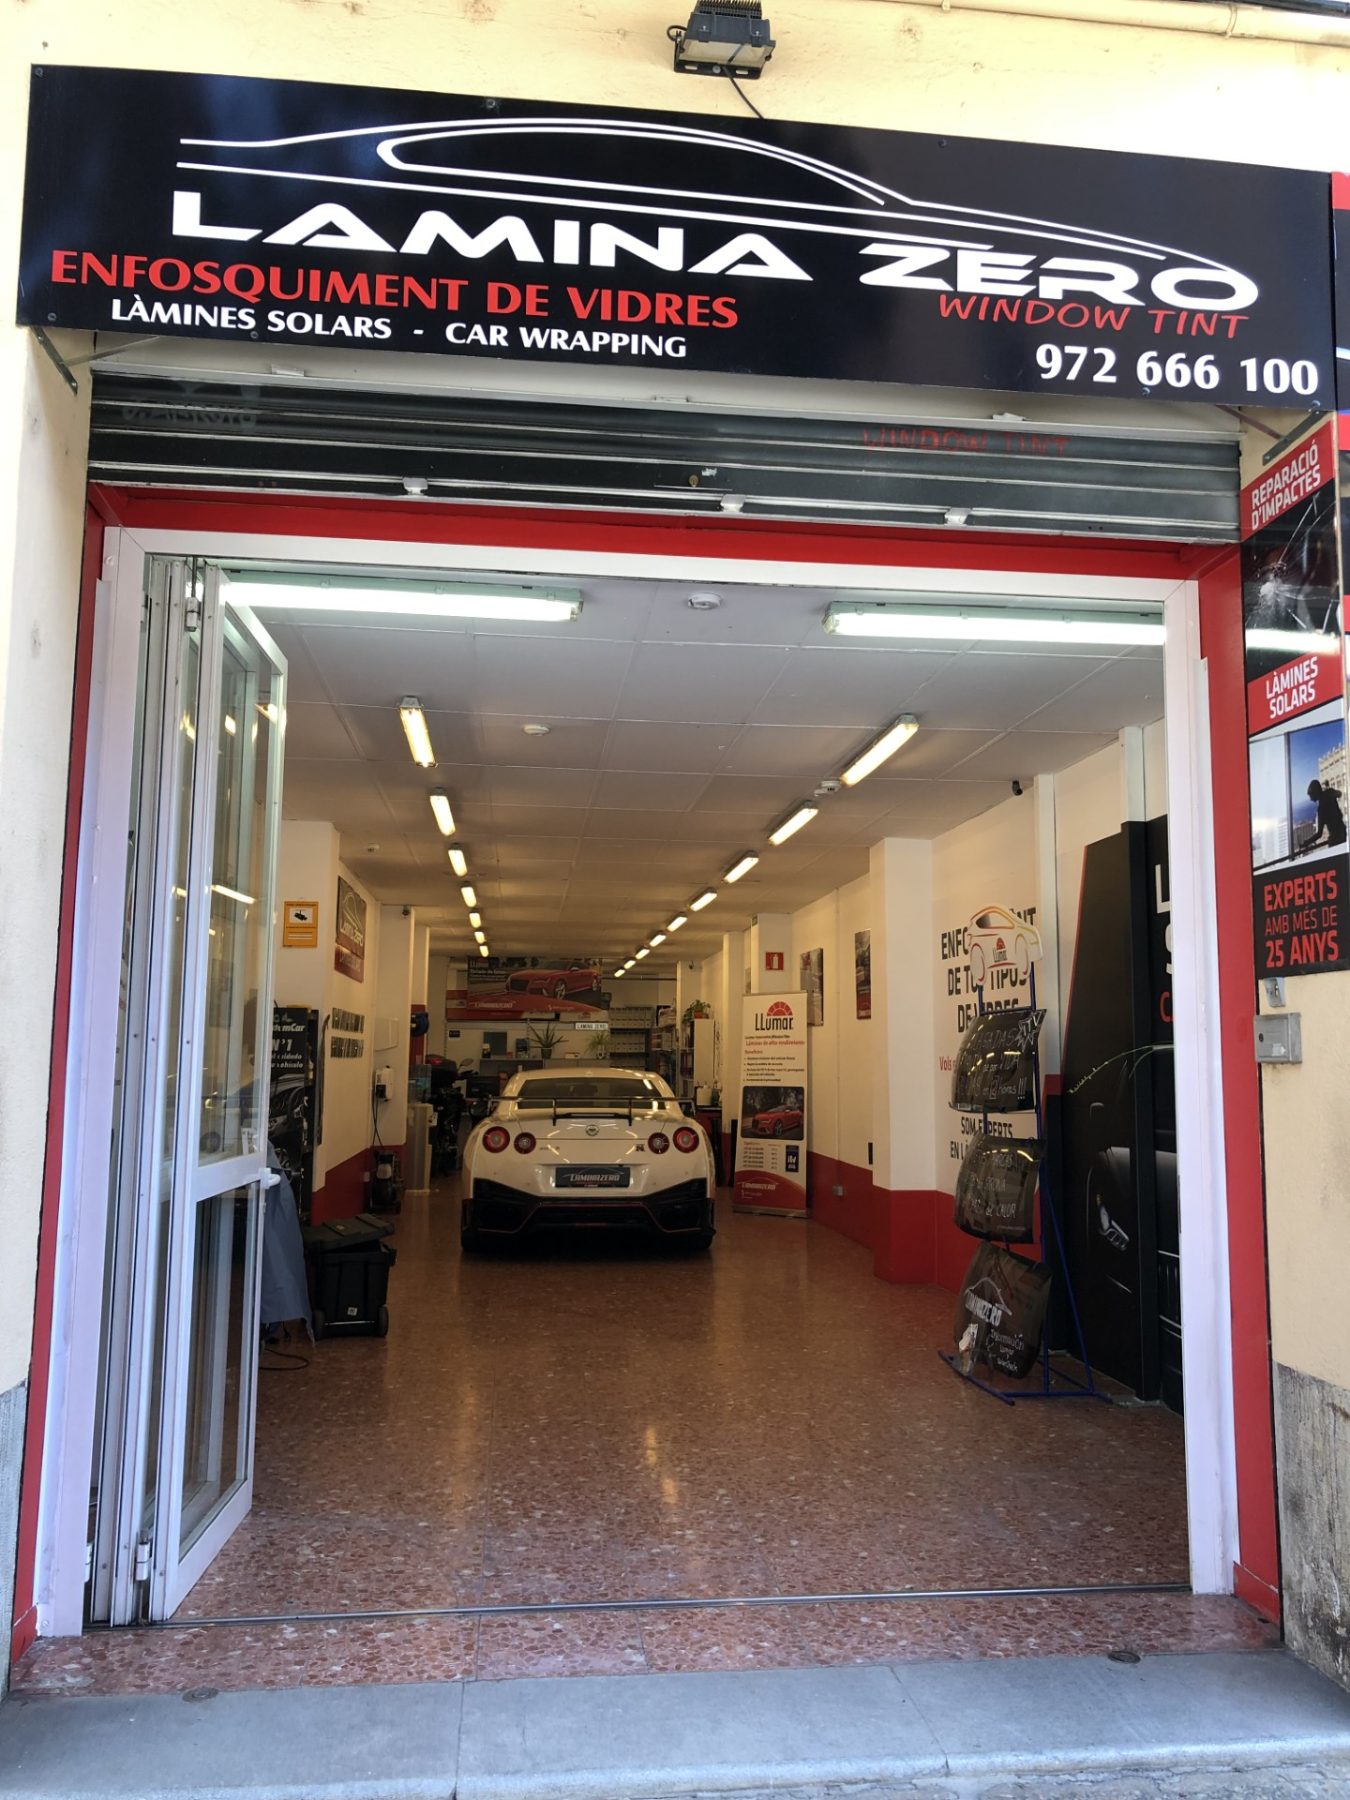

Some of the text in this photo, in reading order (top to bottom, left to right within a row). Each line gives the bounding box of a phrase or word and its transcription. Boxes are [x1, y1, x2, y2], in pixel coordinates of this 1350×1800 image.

[172, 191, 1259, 312] LAMINA ZERO
[51, 249, 739, 329] ENFOSQUIMENT DE VIDRES
[111, 294, 256, 331] LÀMINES
[267, 310, 392, 340] SOLARS
[445, 322, 509, 348] CAR
[519, 325, 687, 358] WRAPPING
[939, 293, 1250, 339] WINDOW TINT
[1035, 343, 1319, 395] 972 666 100
[1251, 439, 1319, 507] REPARACIÓ
[1251, 465, 1321, 531] D'IMPACTES
[1266, 656, 1318, 699] LÀMINES
[1269, 681, 1316, 719] SOLARS
[1264, 869, 1338, 912] EXPERTS
[1264, 905, 1338, 936] AMB MÉS DE
[1266, 930, 1339, 968] 25 ANYS
[755, 1012, 794, 1031] LLumar
